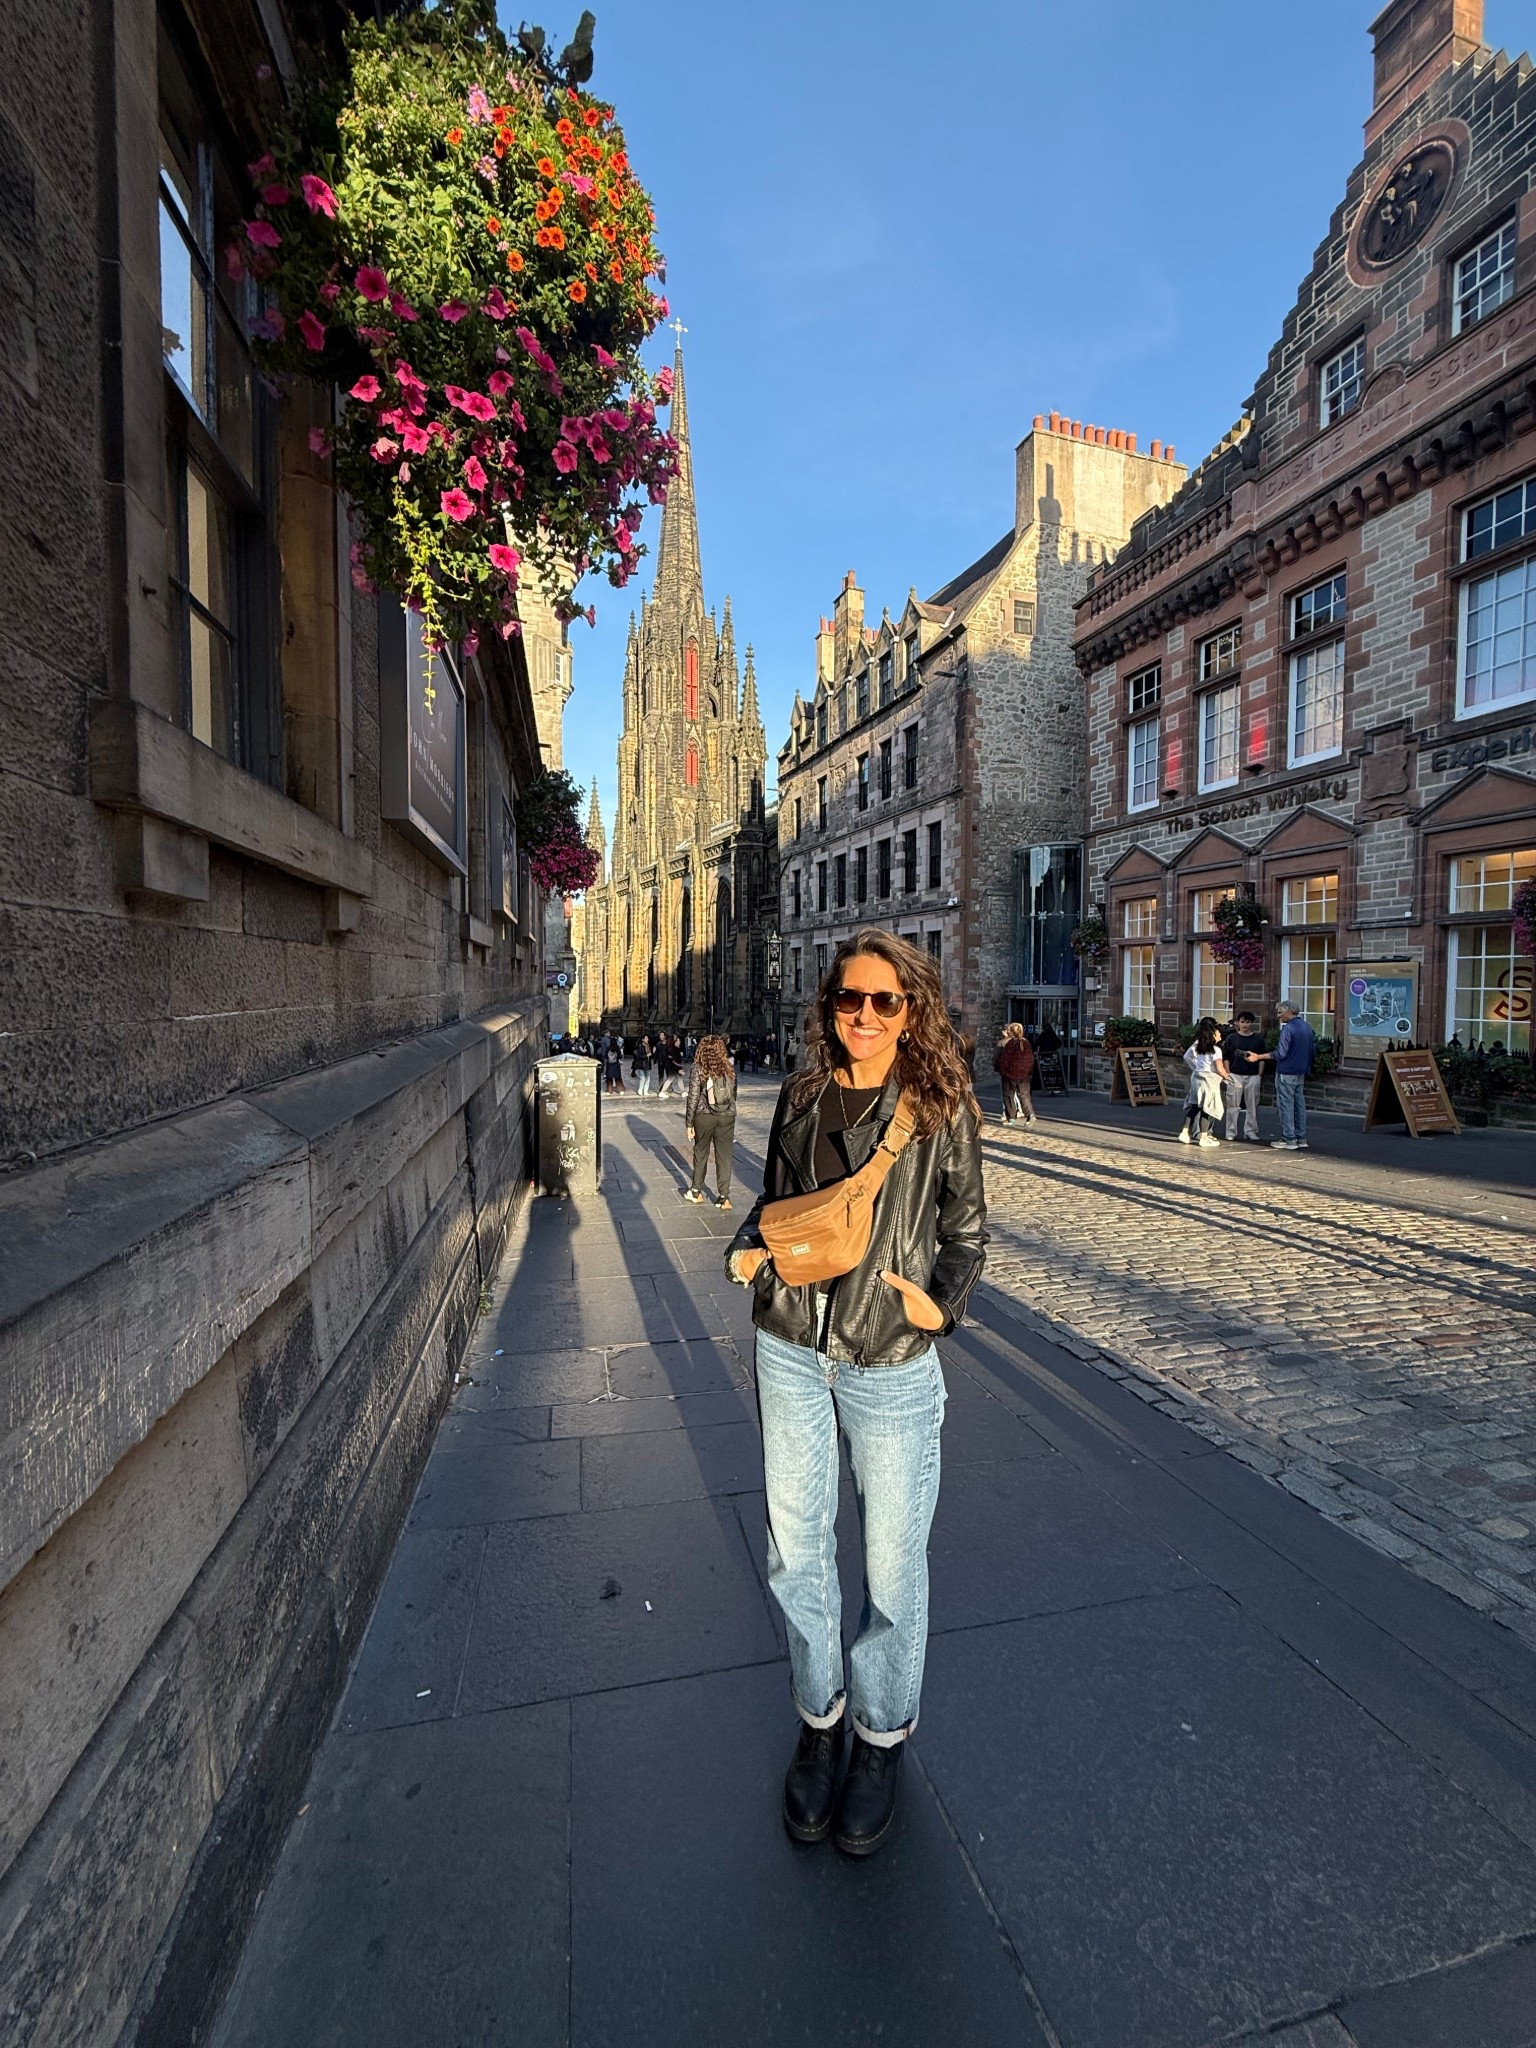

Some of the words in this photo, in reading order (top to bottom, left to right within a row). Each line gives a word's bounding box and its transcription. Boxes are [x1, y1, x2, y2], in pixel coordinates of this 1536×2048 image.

[1265, 430, 1345, 498] CASTLE
[1356, 391, 1411, 438] HILL
[1432, 727, 1536, 772] Experi
[1165, 816, 1194, 835] The
[1198, 799, 1261, 827] Scotch
[1267, 778, 1348, 811] Whisky
